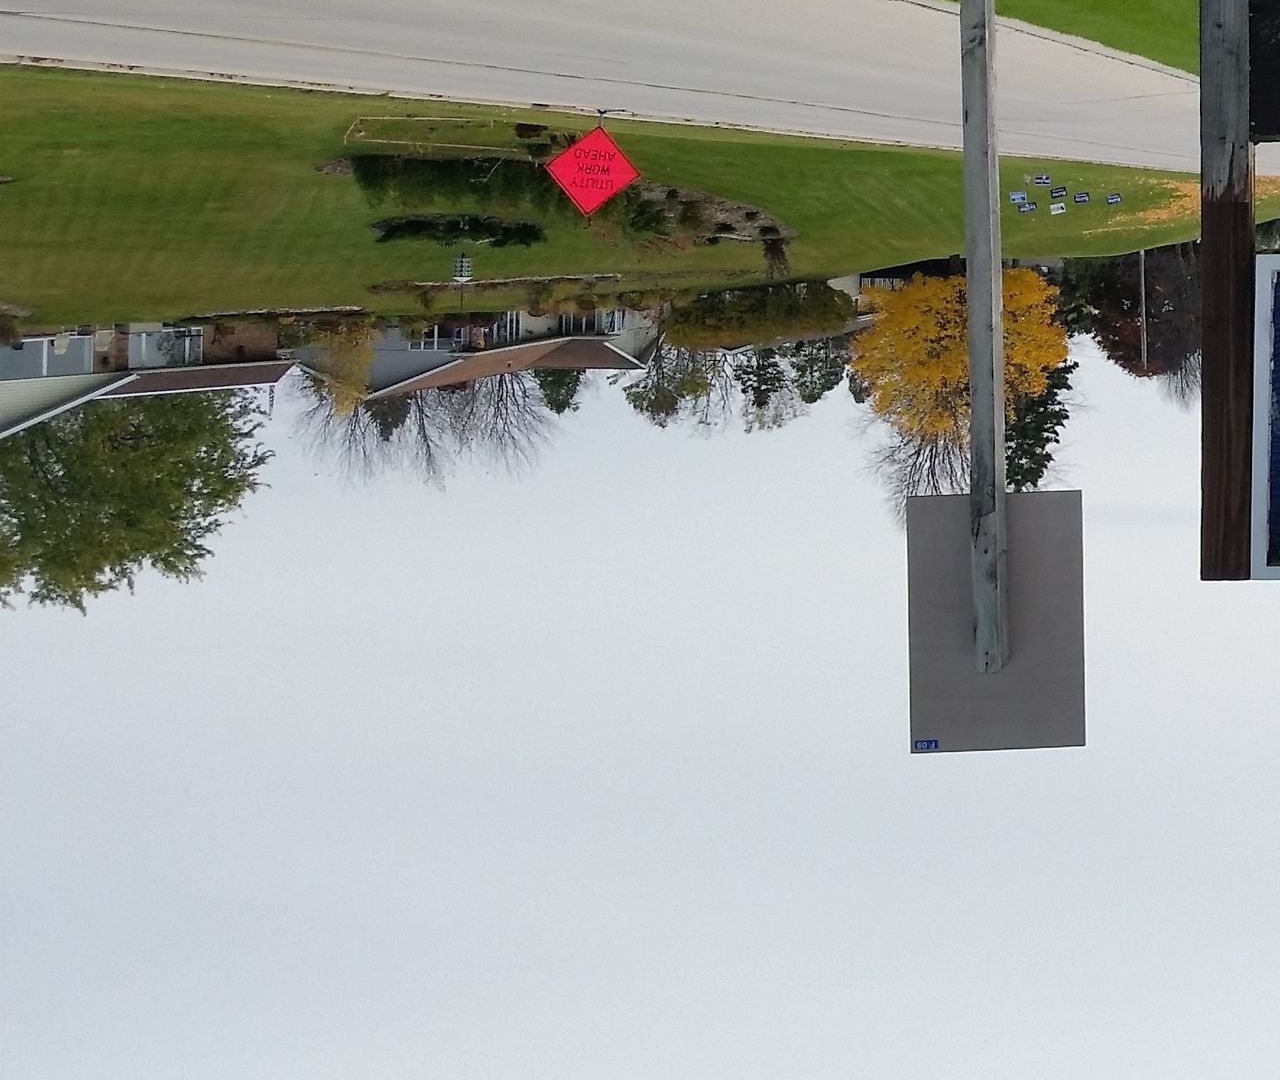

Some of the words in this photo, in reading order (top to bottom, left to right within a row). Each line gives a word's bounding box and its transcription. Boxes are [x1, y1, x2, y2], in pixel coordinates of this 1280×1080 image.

[574, 148, 616, 161] AHEAD
[577, 162, 610, 176] WORK
[570, 177, 614, 190] UTILITY
